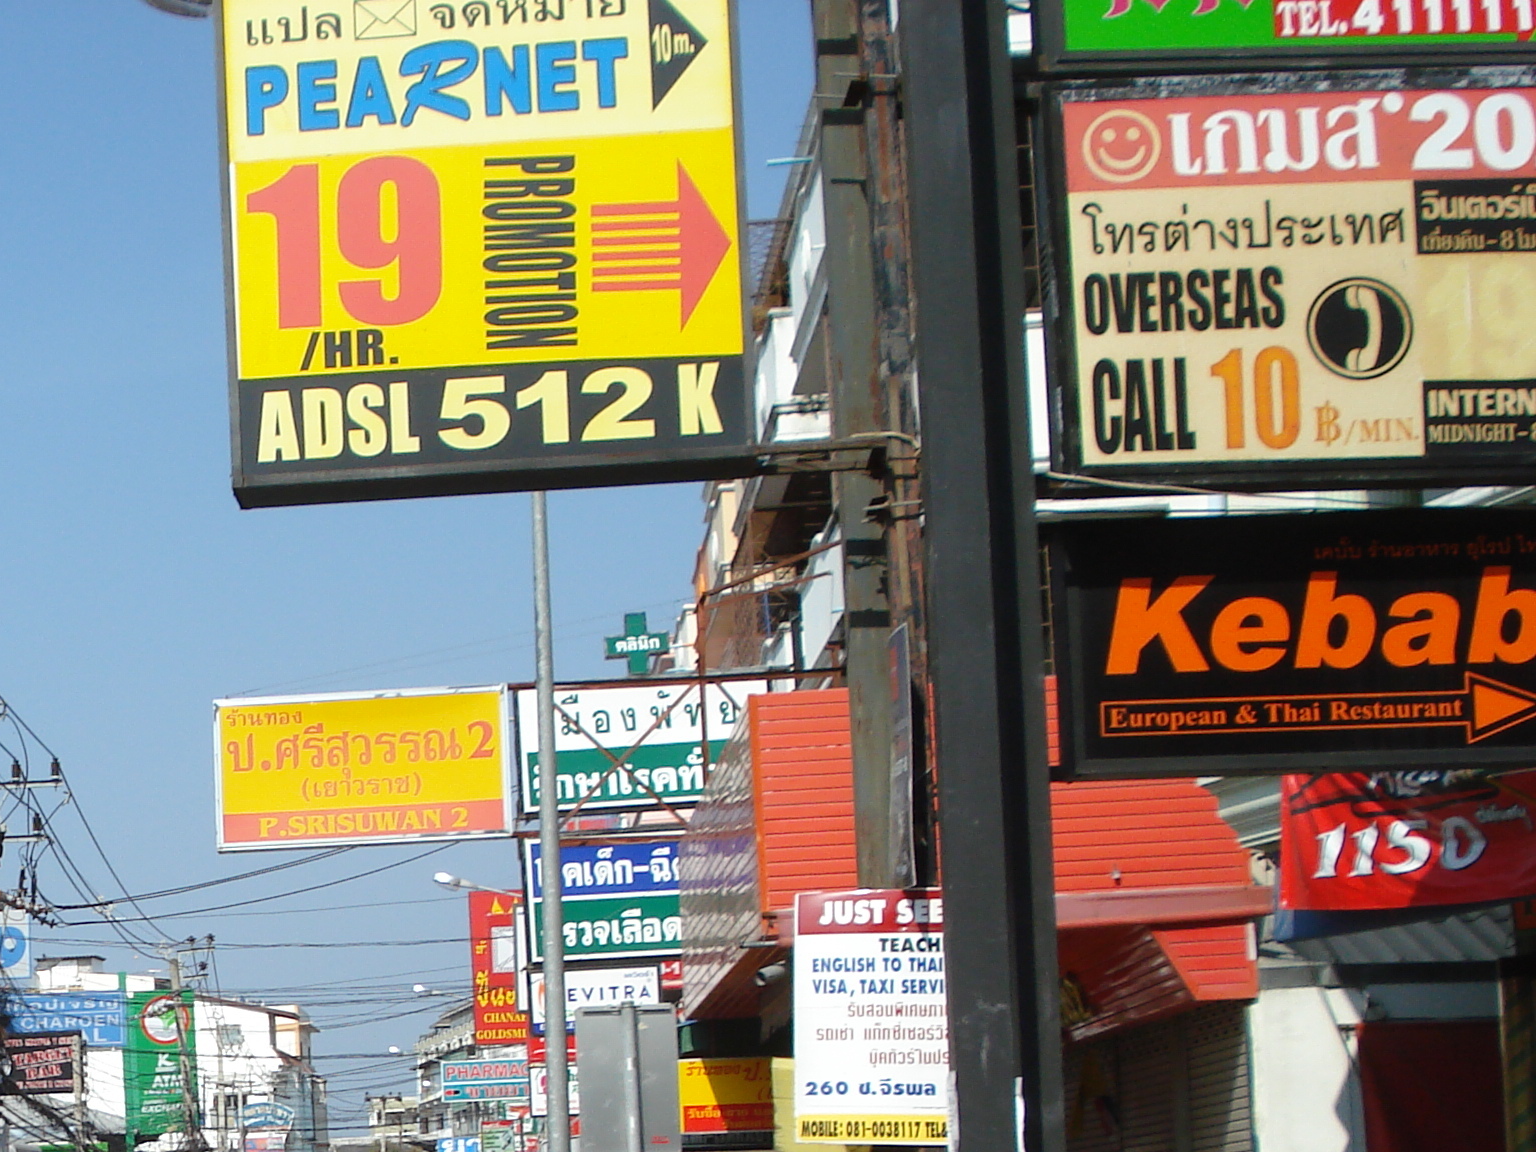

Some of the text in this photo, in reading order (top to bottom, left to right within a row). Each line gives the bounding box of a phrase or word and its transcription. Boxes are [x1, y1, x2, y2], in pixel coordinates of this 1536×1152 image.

[246, 9, 342, 46] แปล
[244, 37, 629, 137] PEARNET
[246, 155, 443, 330] 19
[1081, 199, 1405, 256] โทรต่างประเทศ
[482, 154, 579, 351] PROMOTION
[1083, 266, 1286, 336] OVERSEAS
[300, 328, 400, 371] /HR.
[257, 361, 724, 464] ADSL 512 K
[1092, 357, 1197, 456] CALL
[1210, 345, 1302, 450] 10
[1105, 565, 1536, 676] Kebab
[615, 635, 661, 652] คลินิก
[226, 709, 302, 728] ร้านทอง
[560, 689, 738, 736] มืองพัทย
[1109, 698, 1463, 733] European & Thai Restaurant
[467, 720, 496, 759] 2
[300, 771, 423, 802] (เยาวราช)
[258, 807, 470, 838] P.SRISUWAN 2
[562, 907, 683, 948] รวจเลือด
[818, 899, 887, 926] JUST
[878, 937, 941, 953] TEACH
[812, 957, 876, 973] ENGLISH
[882, 957, 902, 973] TO
[567, 985, 652, 1002] EVITRA
[812, 978, 855, 997] VISA,
[859, 978, 894, 994] TAXI
[20, 1013, 120, 1030] CHAROEN
[25, 1065, 63, 1080] BAR
[804, 1081, 849, 1097] 260
[800, 1121, 844, 1138] MOBILE:
[846, 1120, 921, 1138] 081-0038117
